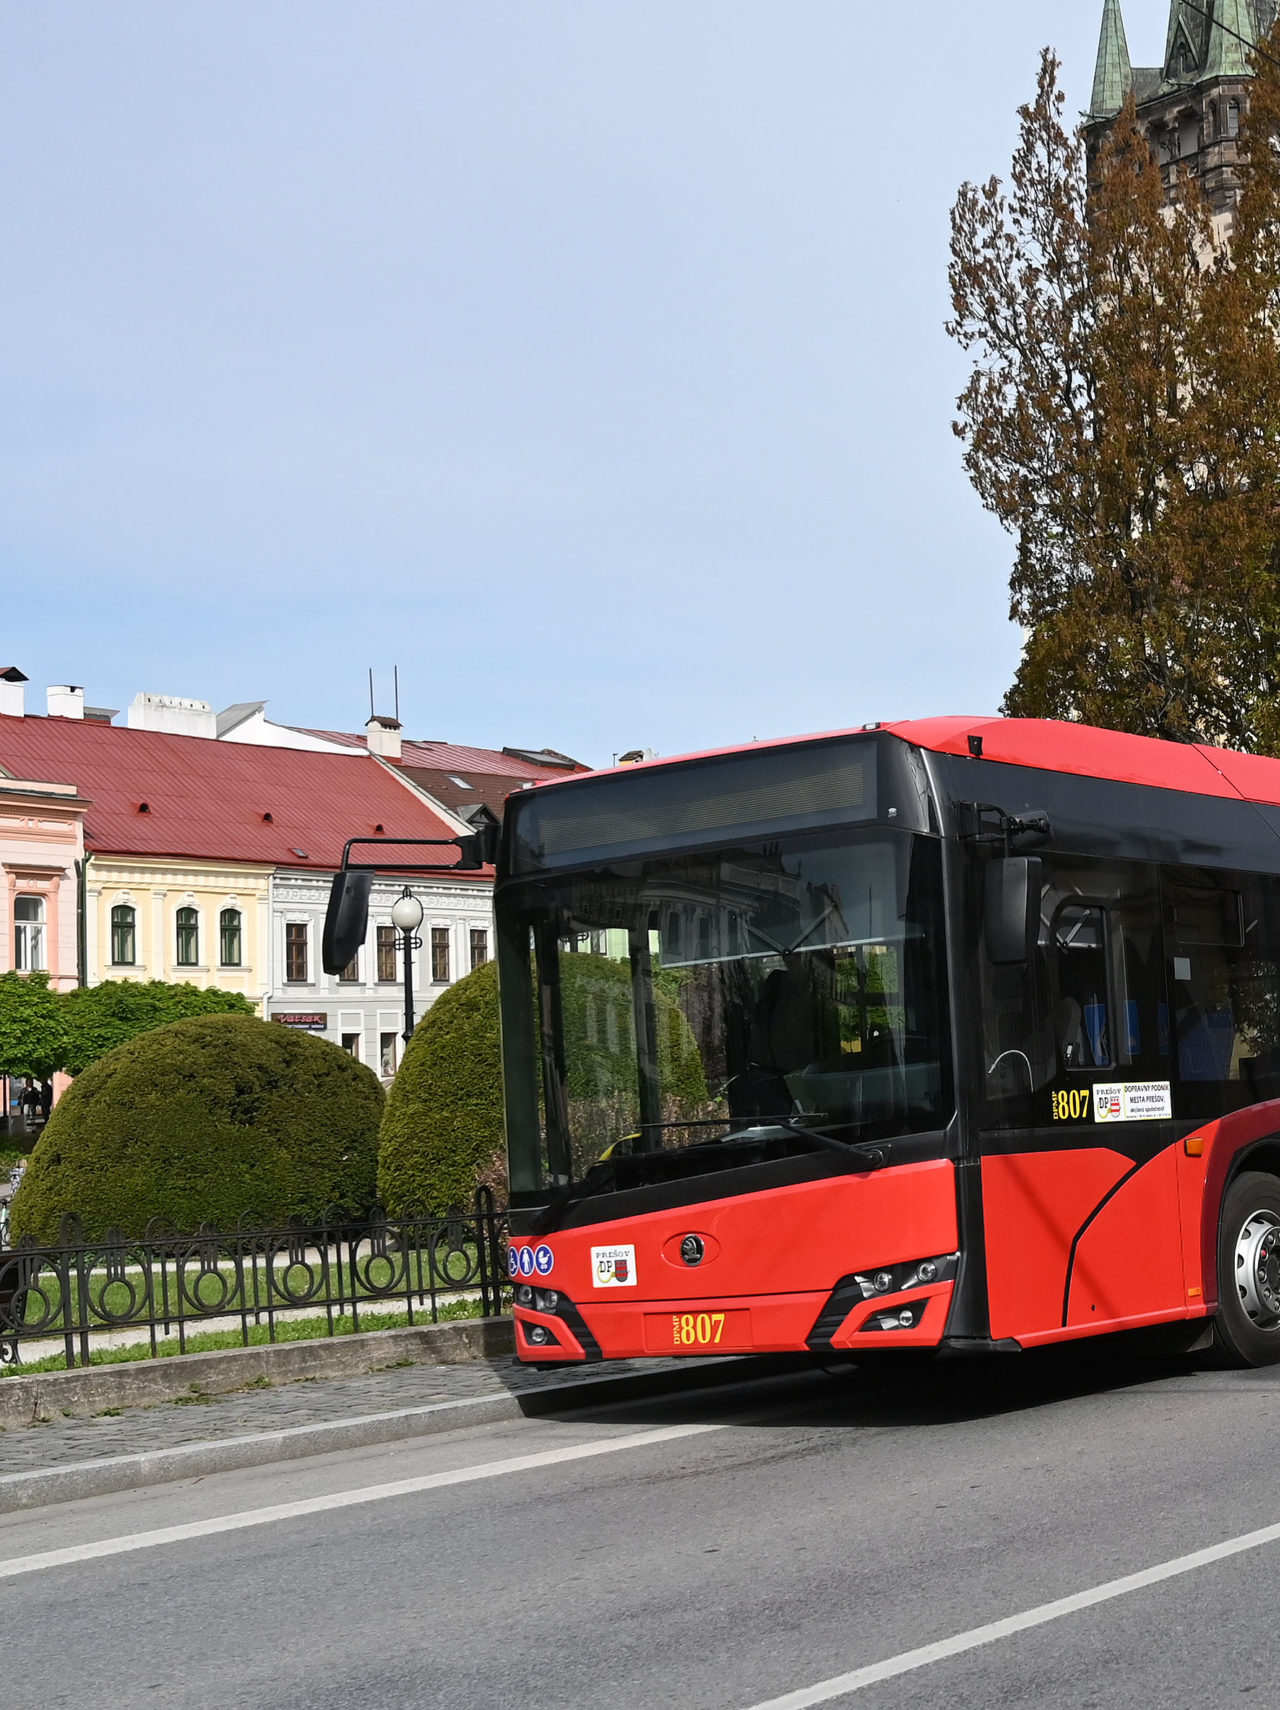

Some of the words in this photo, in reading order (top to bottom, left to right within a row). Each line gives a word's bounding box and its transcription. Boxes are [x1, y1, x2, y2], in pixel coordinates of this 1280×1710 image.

[1096, 1087, 1121, 1095] PREŠOV
[1058, 1089, 1090, 1120] 807
[1099, 1097, 1109, 1109] DP
[1129, 1096, 1146, 1104] MESTA
[596, 1250, 630, 1259] PREŠOV
[599, 1260, 613, 1273] DP
[681, 1313, 726, 1345] 807
